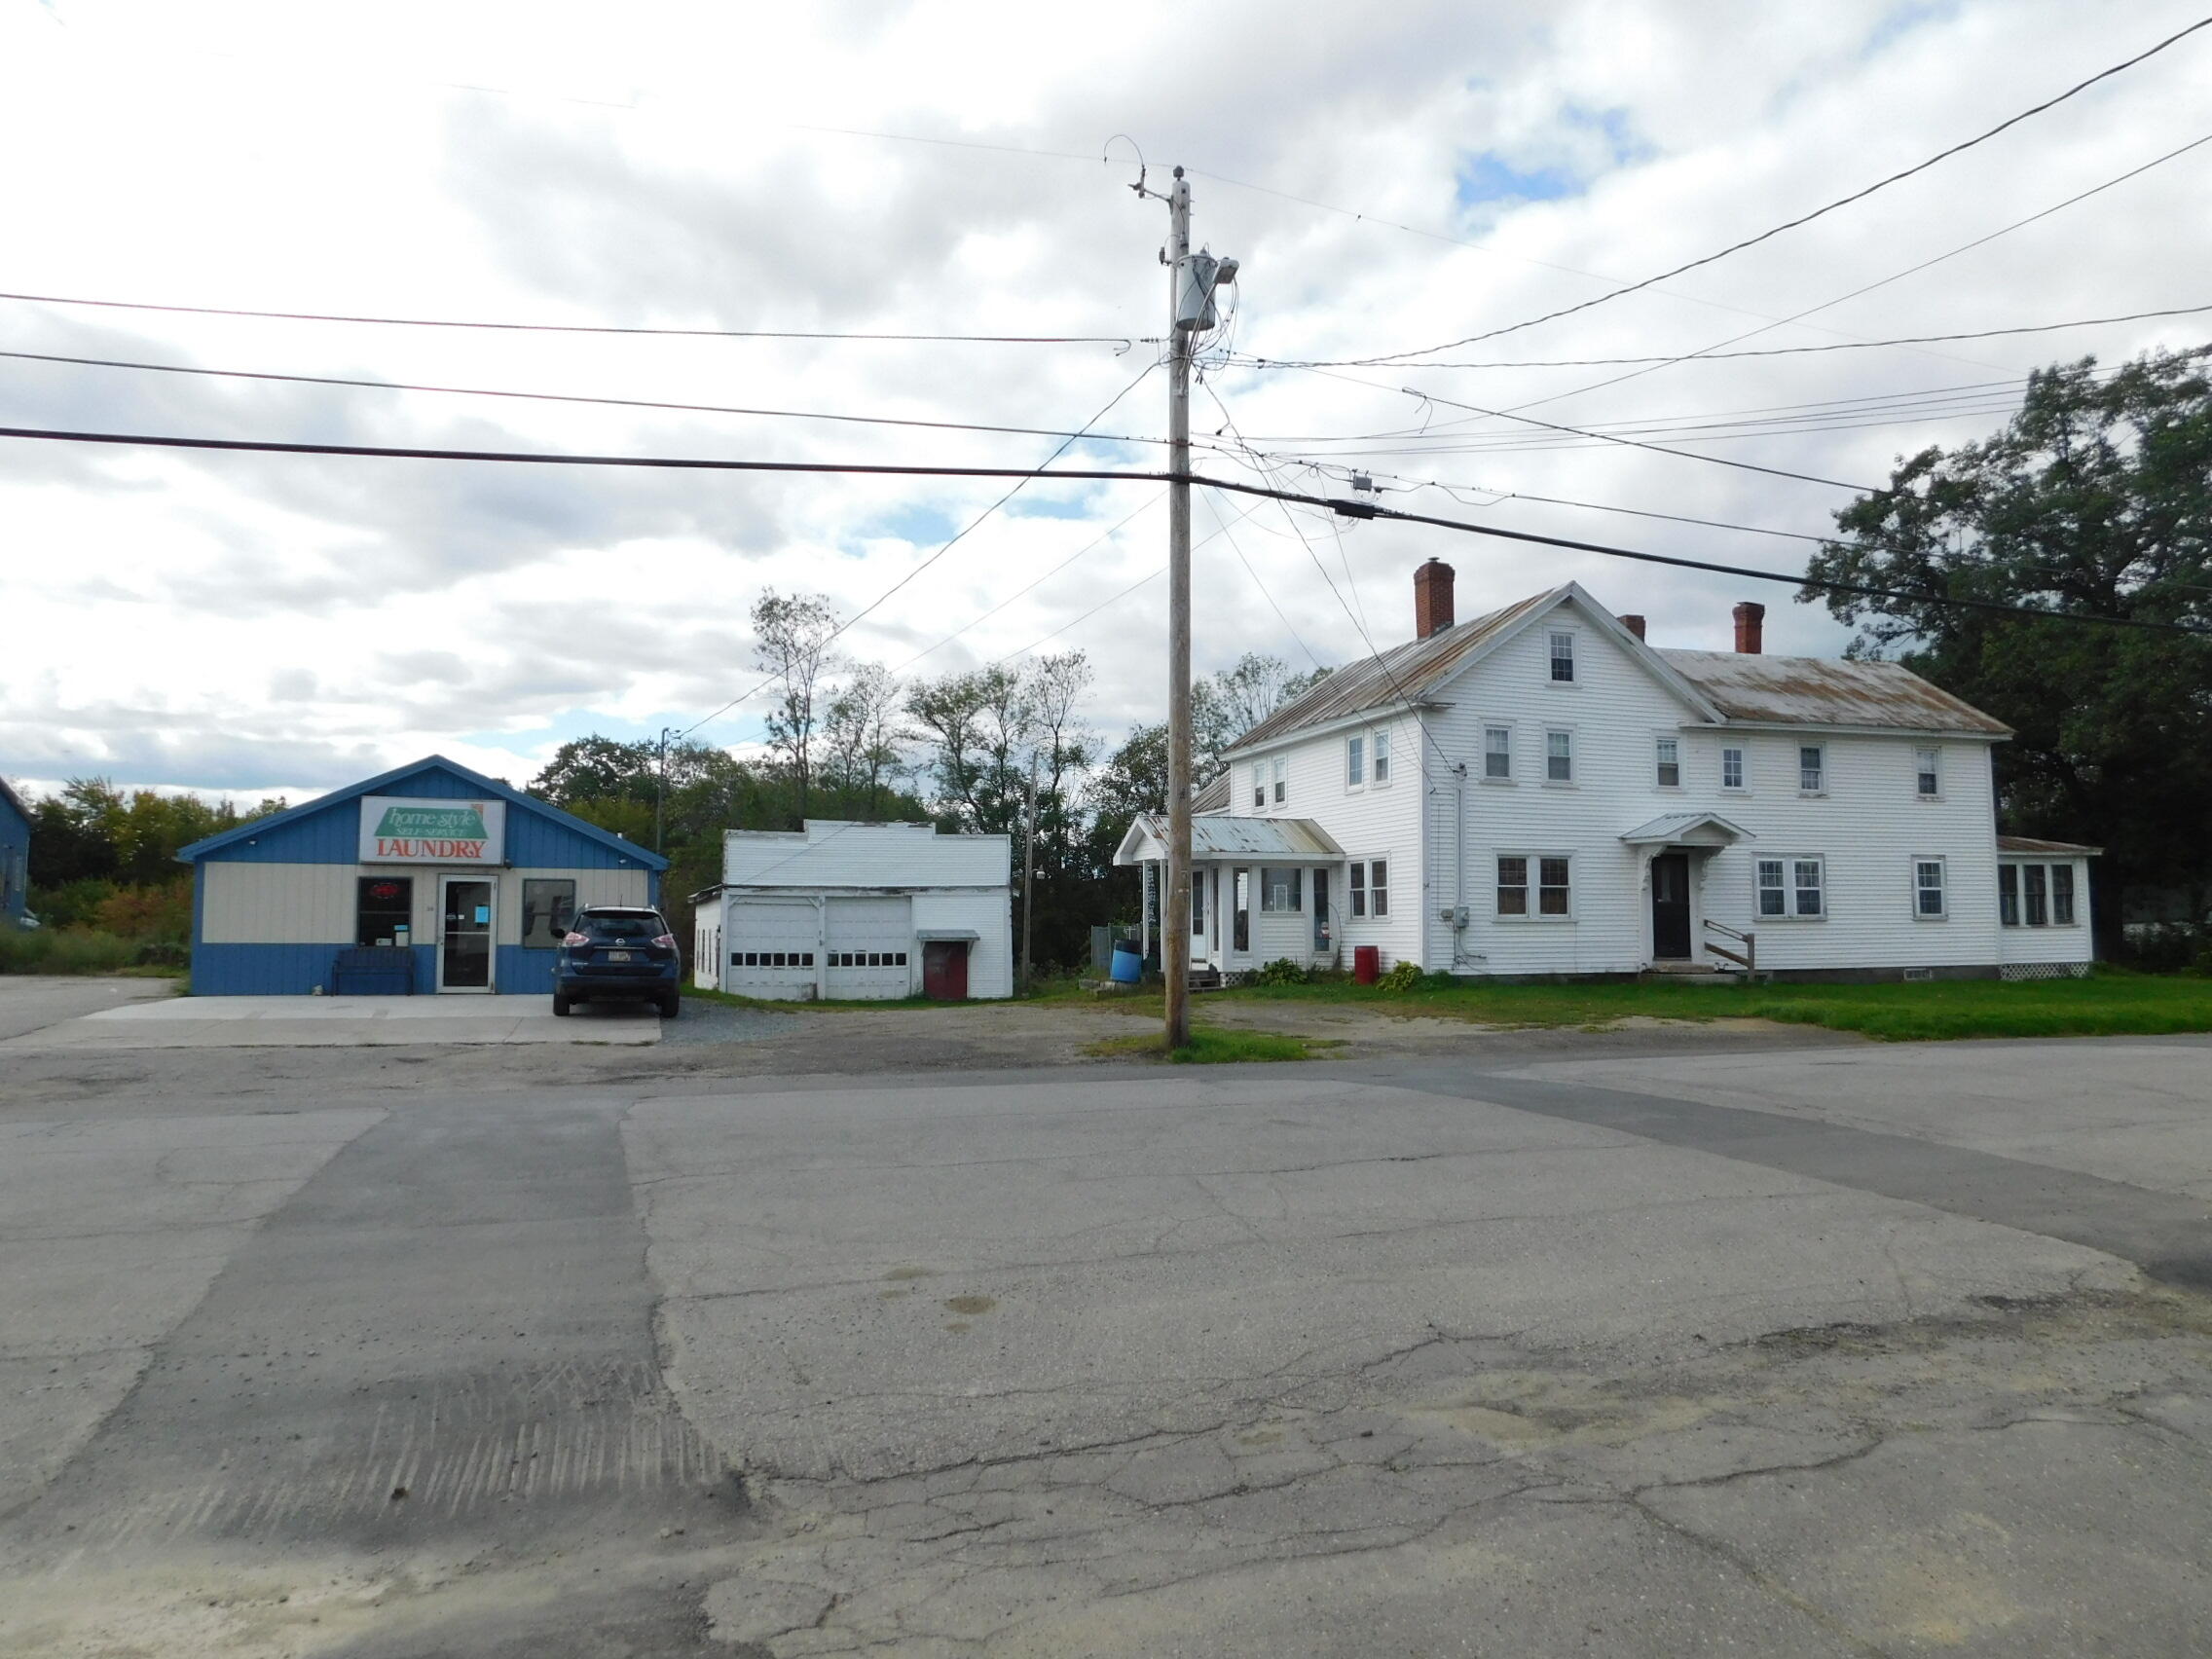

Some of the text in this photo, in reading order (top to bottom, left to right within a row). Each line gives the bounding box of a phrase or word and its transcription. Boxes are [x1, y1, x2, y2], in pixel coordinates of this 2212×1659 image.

[389, 808, 476, 828] home style
[377, 838, 487, 858] LAUNDRY
